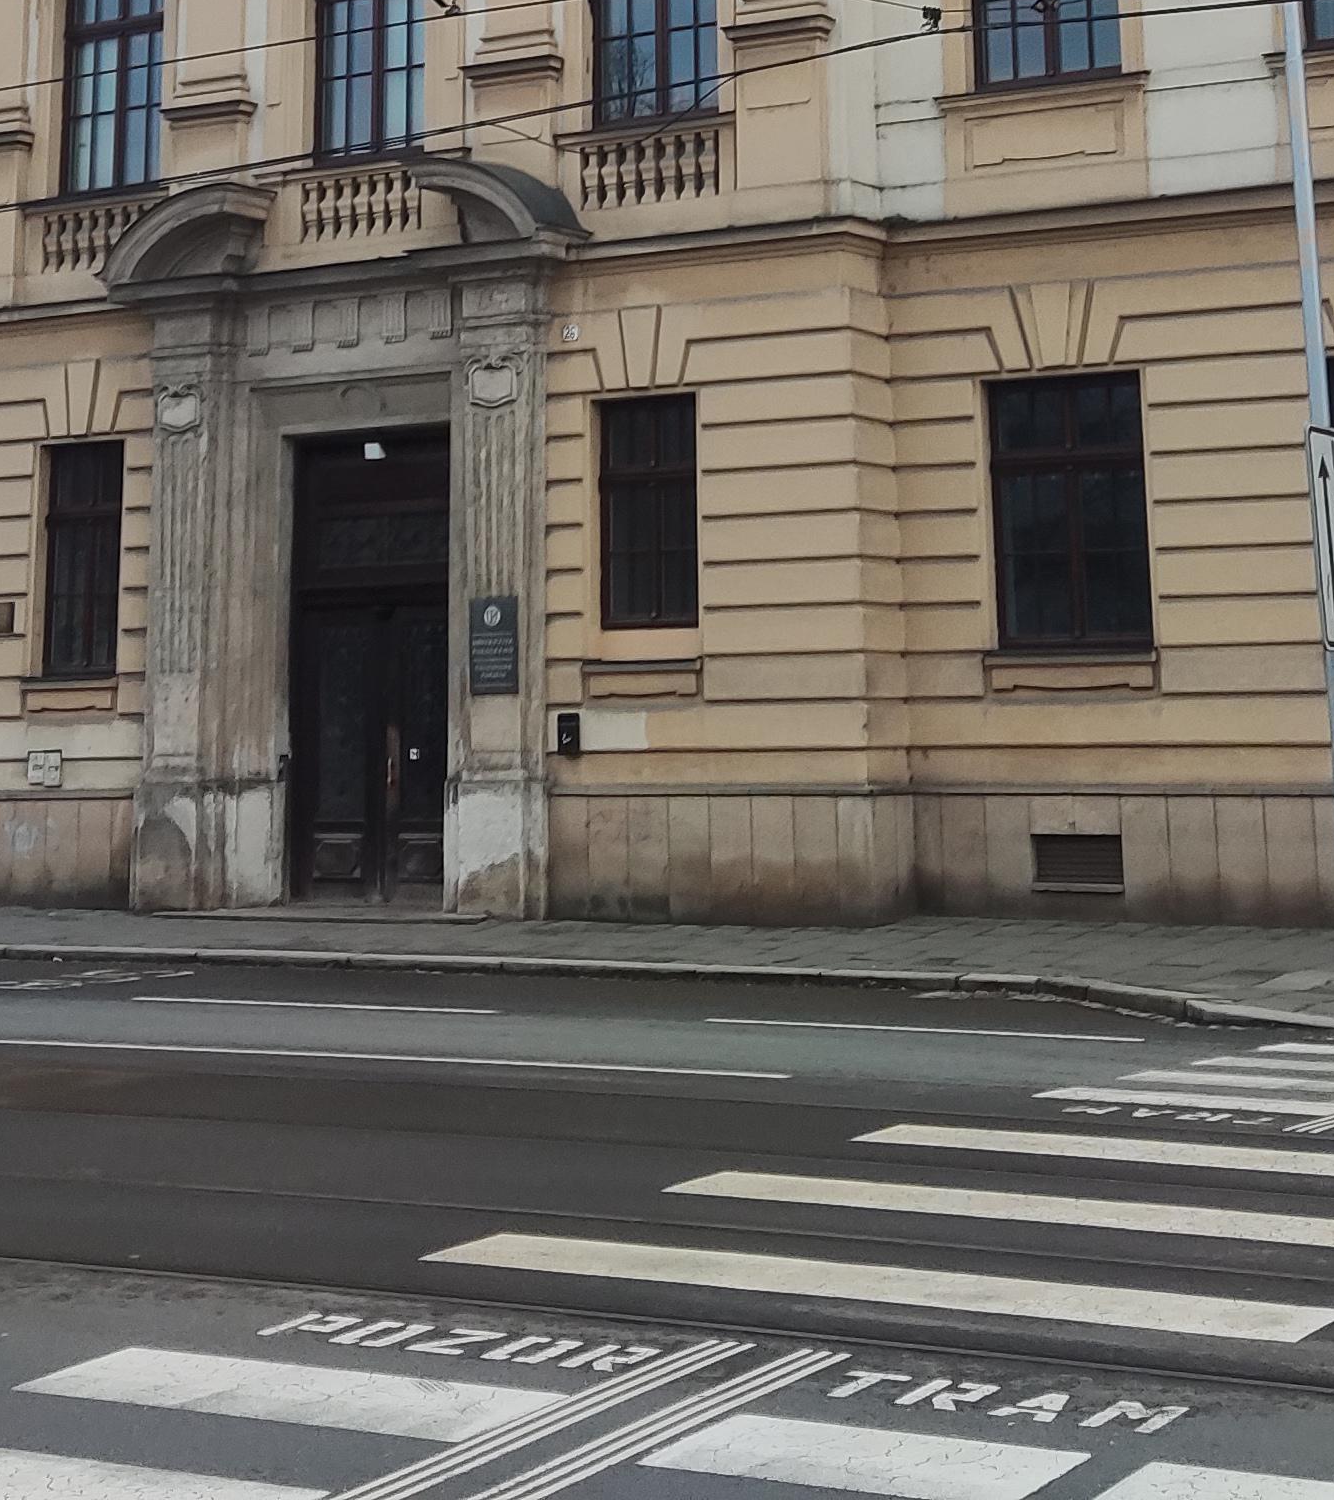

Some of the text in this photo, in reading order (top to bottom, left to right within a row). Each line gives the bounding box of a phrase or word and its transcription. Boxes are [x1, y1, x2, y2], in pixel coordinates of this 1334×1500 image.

[1061, 1105, 1276, 1125] TRAM
[256, 1312, 1191, 1434] POZOR TRAM
